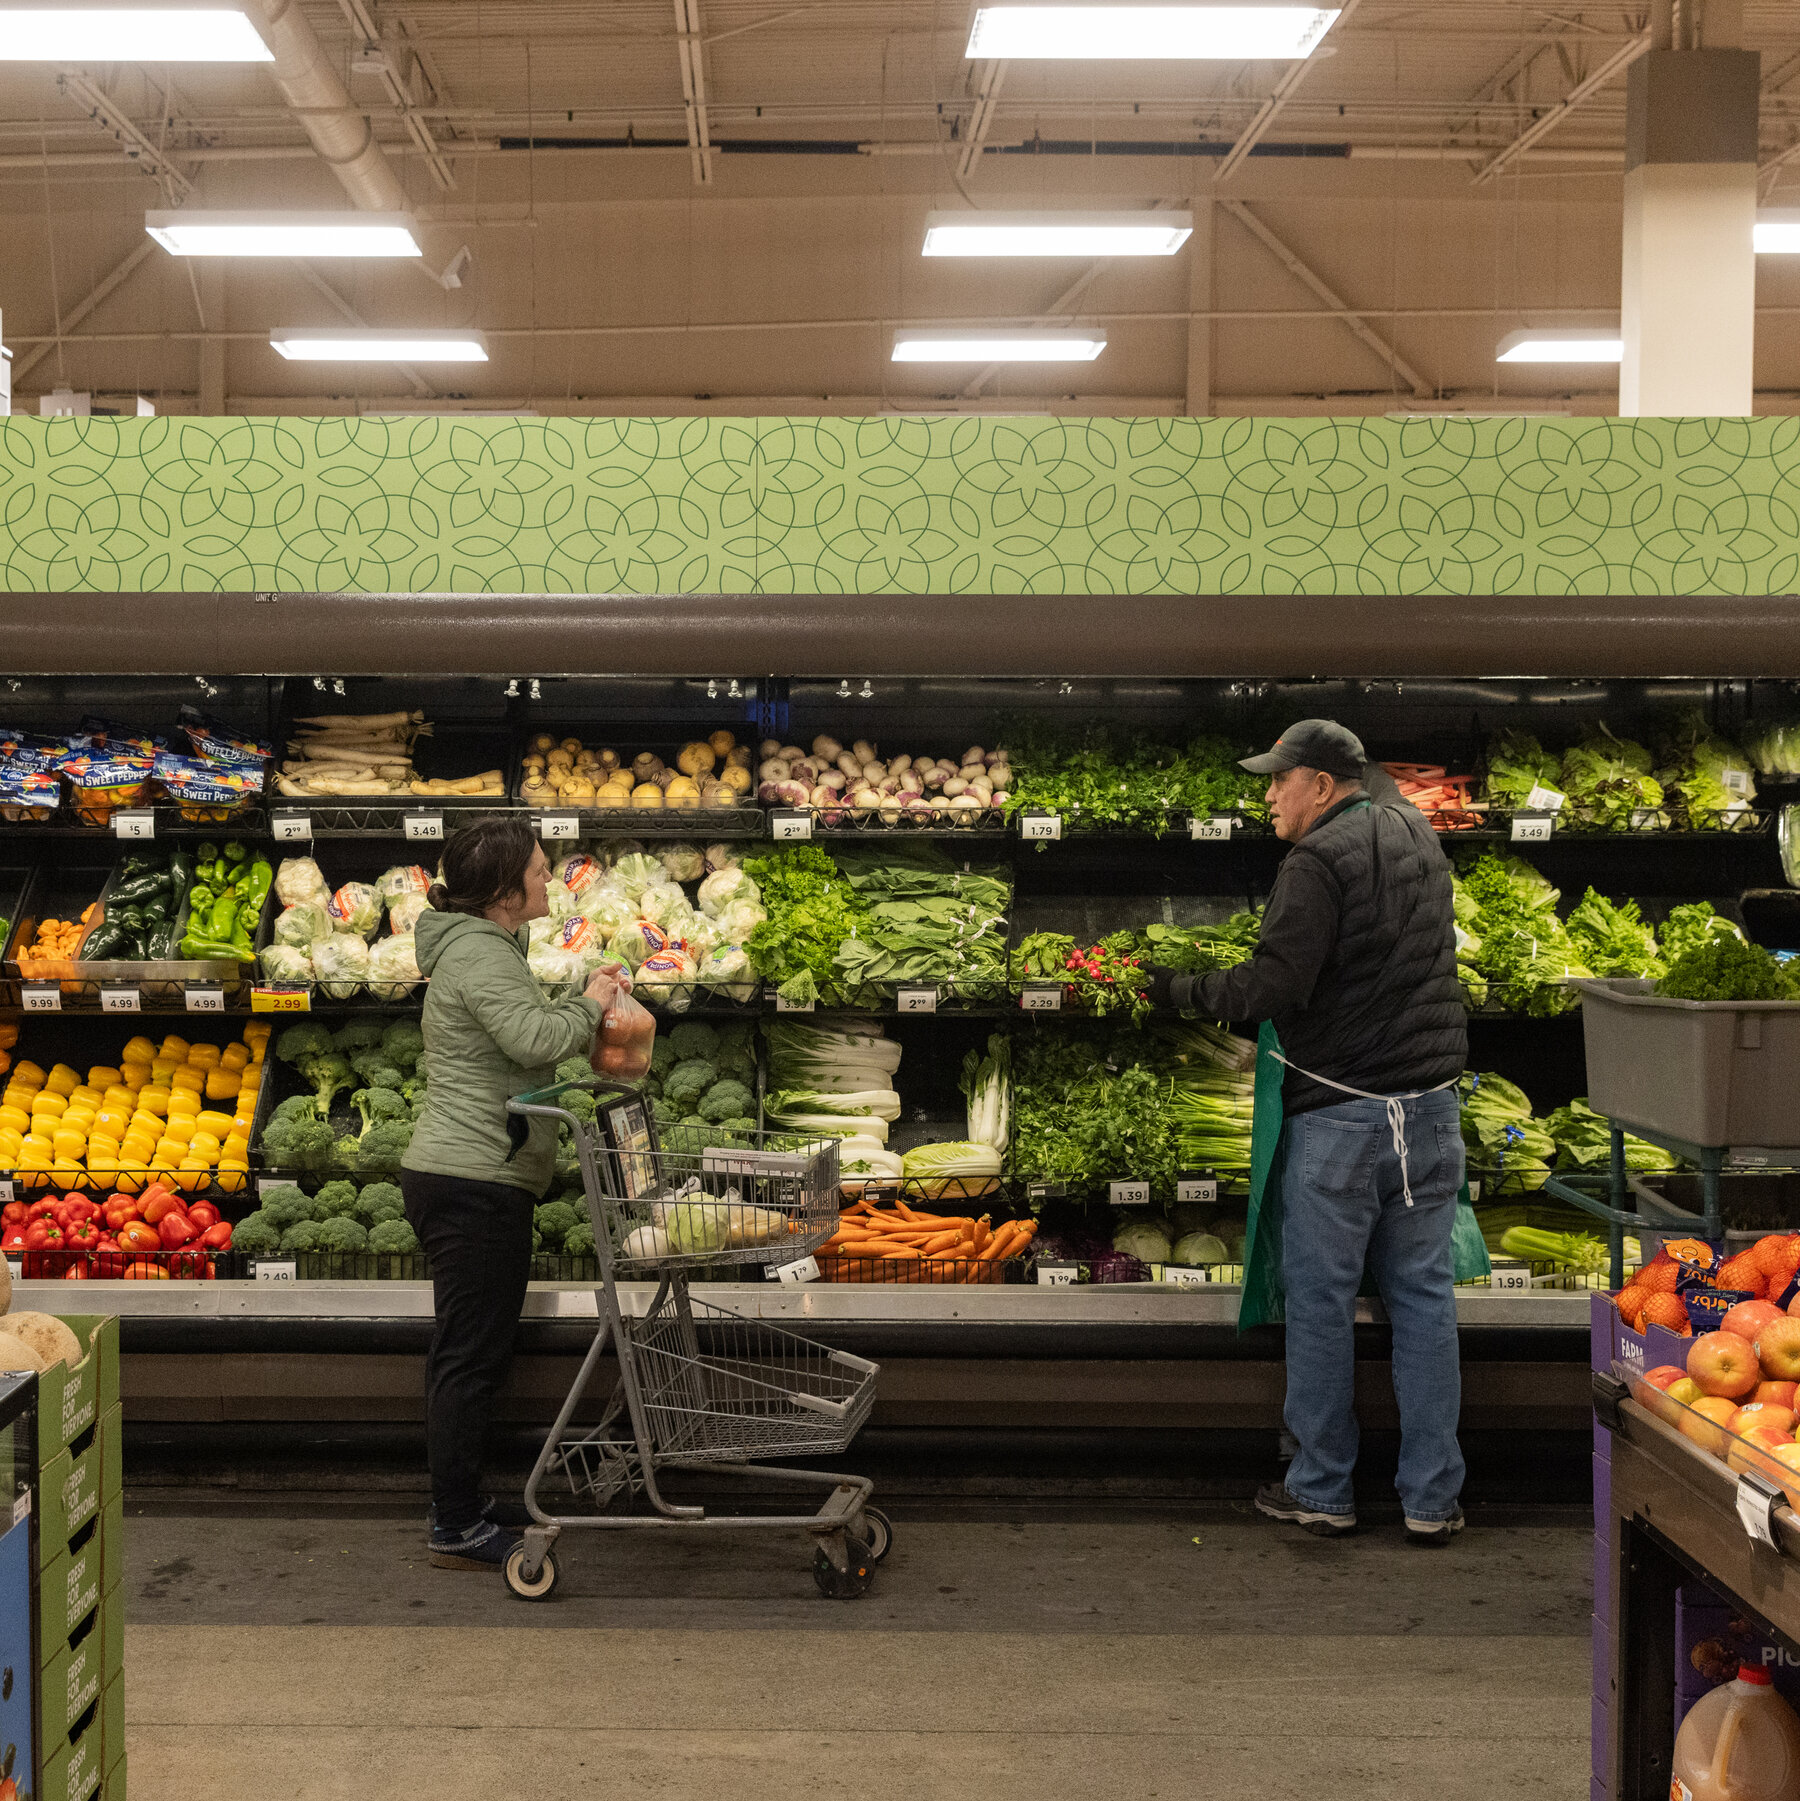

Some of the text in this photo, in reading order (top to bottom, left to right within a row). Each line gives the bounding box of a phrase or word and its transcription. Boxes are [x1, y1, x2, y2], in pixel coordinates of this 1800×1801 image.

[272, 592, 278, 602] G
[183, 787, 213, 801] SWEET
[412, 826, 437, 836] 3.49
[1031, 826, 1053, 836] 1.79
[1200, 827, 1222, 837] 1.79
[1519, 828, 1543, 838] 3.49
[30, 999, 53, 1008] 9.99
[110, 999, 133, 1008] 4.99
[194, 999, 217, 1009] 4.99
[273, 999, 301, 1009] 2.99
[1030, 999, 1053, 1008] 2.29
[1117, 1191, 1143, 1201] 1.39
[1185, 1190, 1210, 1199] 1.29
[1497, 1277, 1524, 1288] 1.99
[63, 1373, 82, 1403] FRESH
[63, 1398, 76, 1422] FOR
[67, 1556, 86, 1590] FRESH
[67, 1583, 80, 1609] FOR
[67, 1650, 86, 1686] FRESH
[67, 1677, 80, 1705] FOR
[67, 1743, 86, 1781] FRESH
[67, 1770, 80, 1800] FOR
